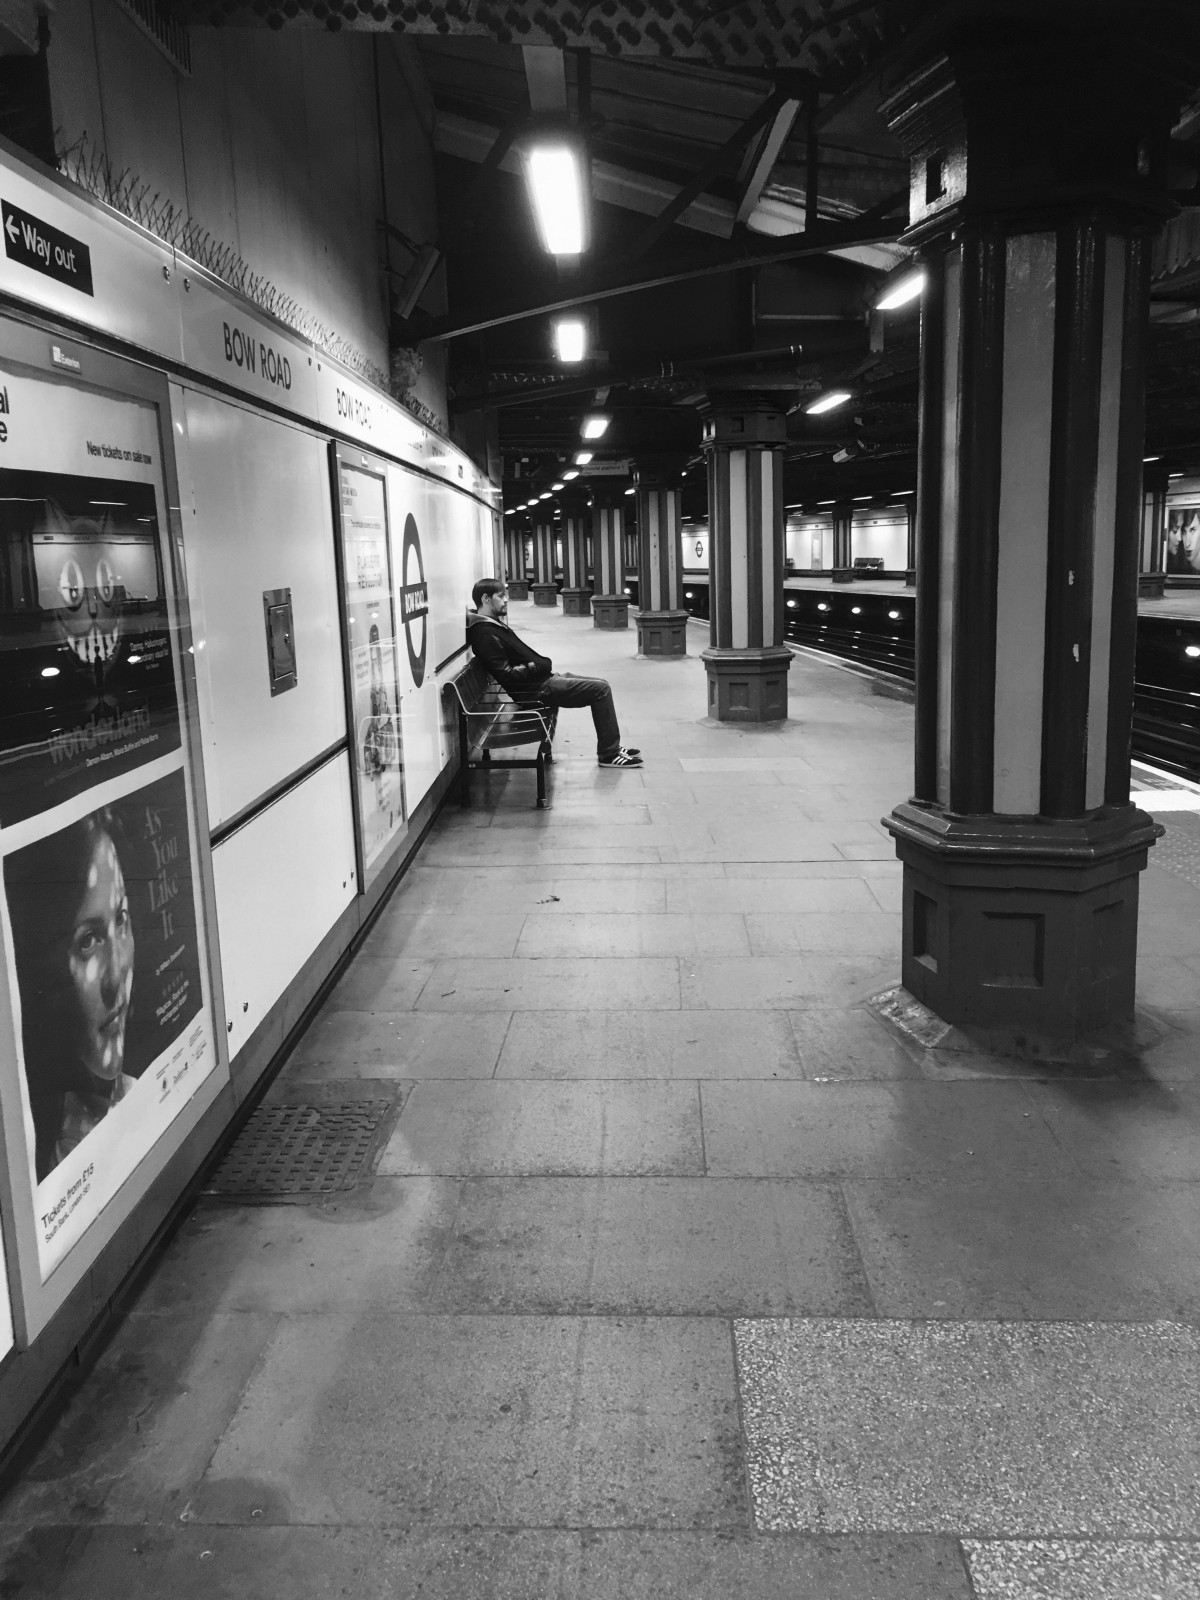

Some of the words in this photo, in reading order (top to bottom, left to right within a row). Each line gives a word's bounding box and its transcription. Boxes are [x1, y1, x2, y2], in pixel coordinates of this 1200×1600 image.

[21, 220, 50, 266] Way
[54, 246, 77, 273] out
[223, 321, 256, 374] BOW
[260, 343, 291, 390] ROAD
[336, 387, 354, 422] BOW
[86, 440, 102, 456] New
[102, 444, 123, 460] tickets
[123, 450, 133, 462] on
[132, 449, 143, 463] sale
[404, 592, 415, 614] BOW
[151, 836, 178, 870] You
[149, 869, 179, 913] Like
[161, 908, 175, 941] It
[41, 1196, 66, 1229] Tickets
[67, 1178, 82, 1200] from
[83, 1162, 94, 1183] £15
[45, 1225, 58, 1243] South
